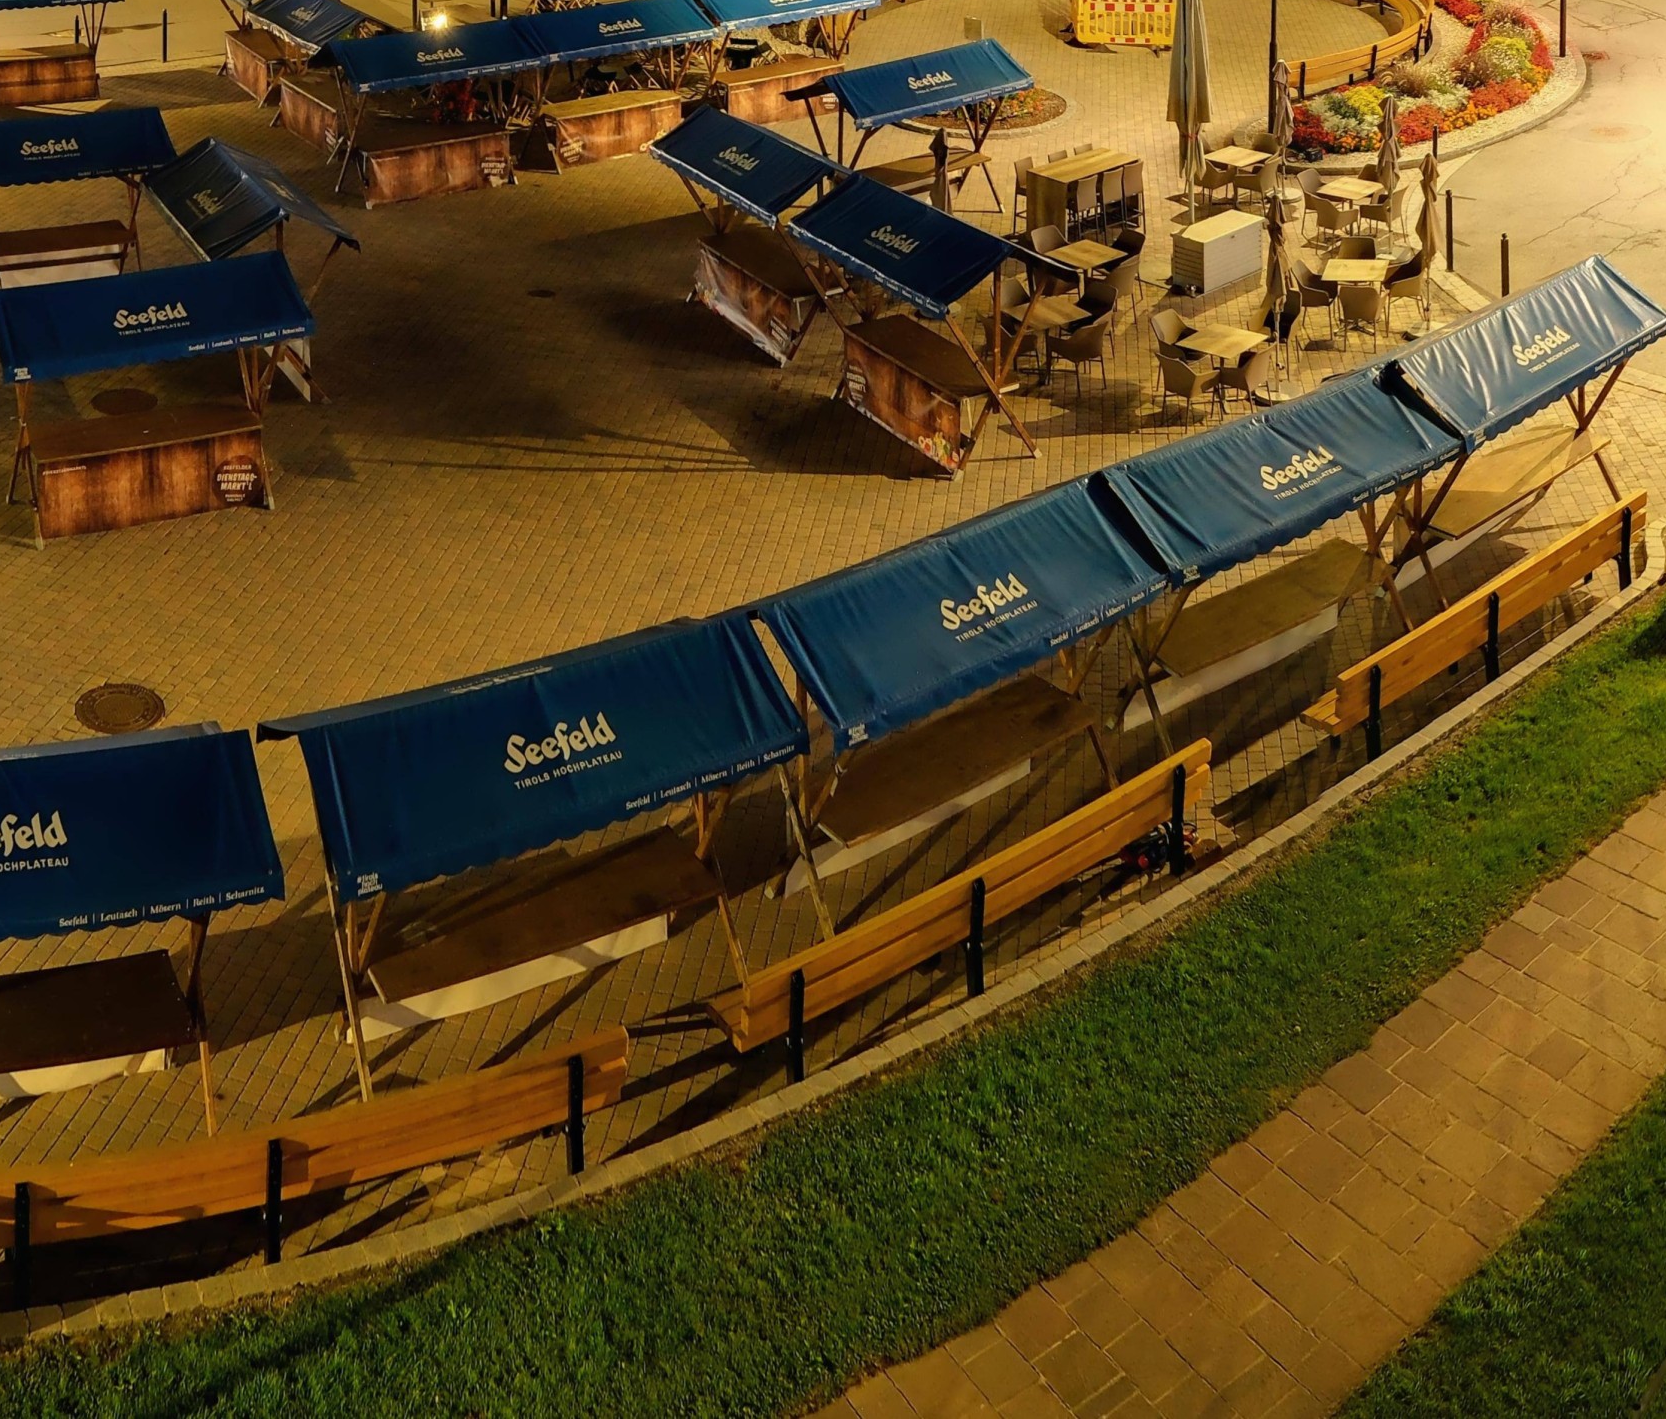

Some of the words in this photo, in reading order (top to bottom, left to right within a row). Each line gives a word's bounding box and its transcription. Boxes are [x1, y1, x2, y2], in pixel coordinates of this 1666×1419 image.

[598, 17, 643, 34] Seefeld
[416, 47, 464, 63] Seefeld
[907, 70, 953, 90] Seefeld
[20, 137, 79, 157] Seefeld
[719, 146, 761, 172] Seefeld
[871, 225, 920, 255] Seefeld
[113, 301, 188, 329] Seefeld
[1512, 324, 1571, 366] Seefeld
[1260, 444, 1334, 491] Seefeld
[940, 572, 1028, 631] Seefeld
[955, 626, 985, 643] TIROLS
[985, 599, 1039, 630] HOCHPLATEAU
[503, 711, 617, 774] Seefeld
[514, 771, 551, 790] TIROLS
[552, 749, 624, 779] HOCHPLATEAU
[625, 793, 651, 811] Seefeld
[660, 780, 692, 799] Leutasch
[59, 913, 88, 928] Seefeld
[100, 907, 138, 923] Leutasch
[150, 901, 182, 916] Mösern
[192, 894, 215, 908] Reith
[225, 885, 265, 902] Scharnitz
